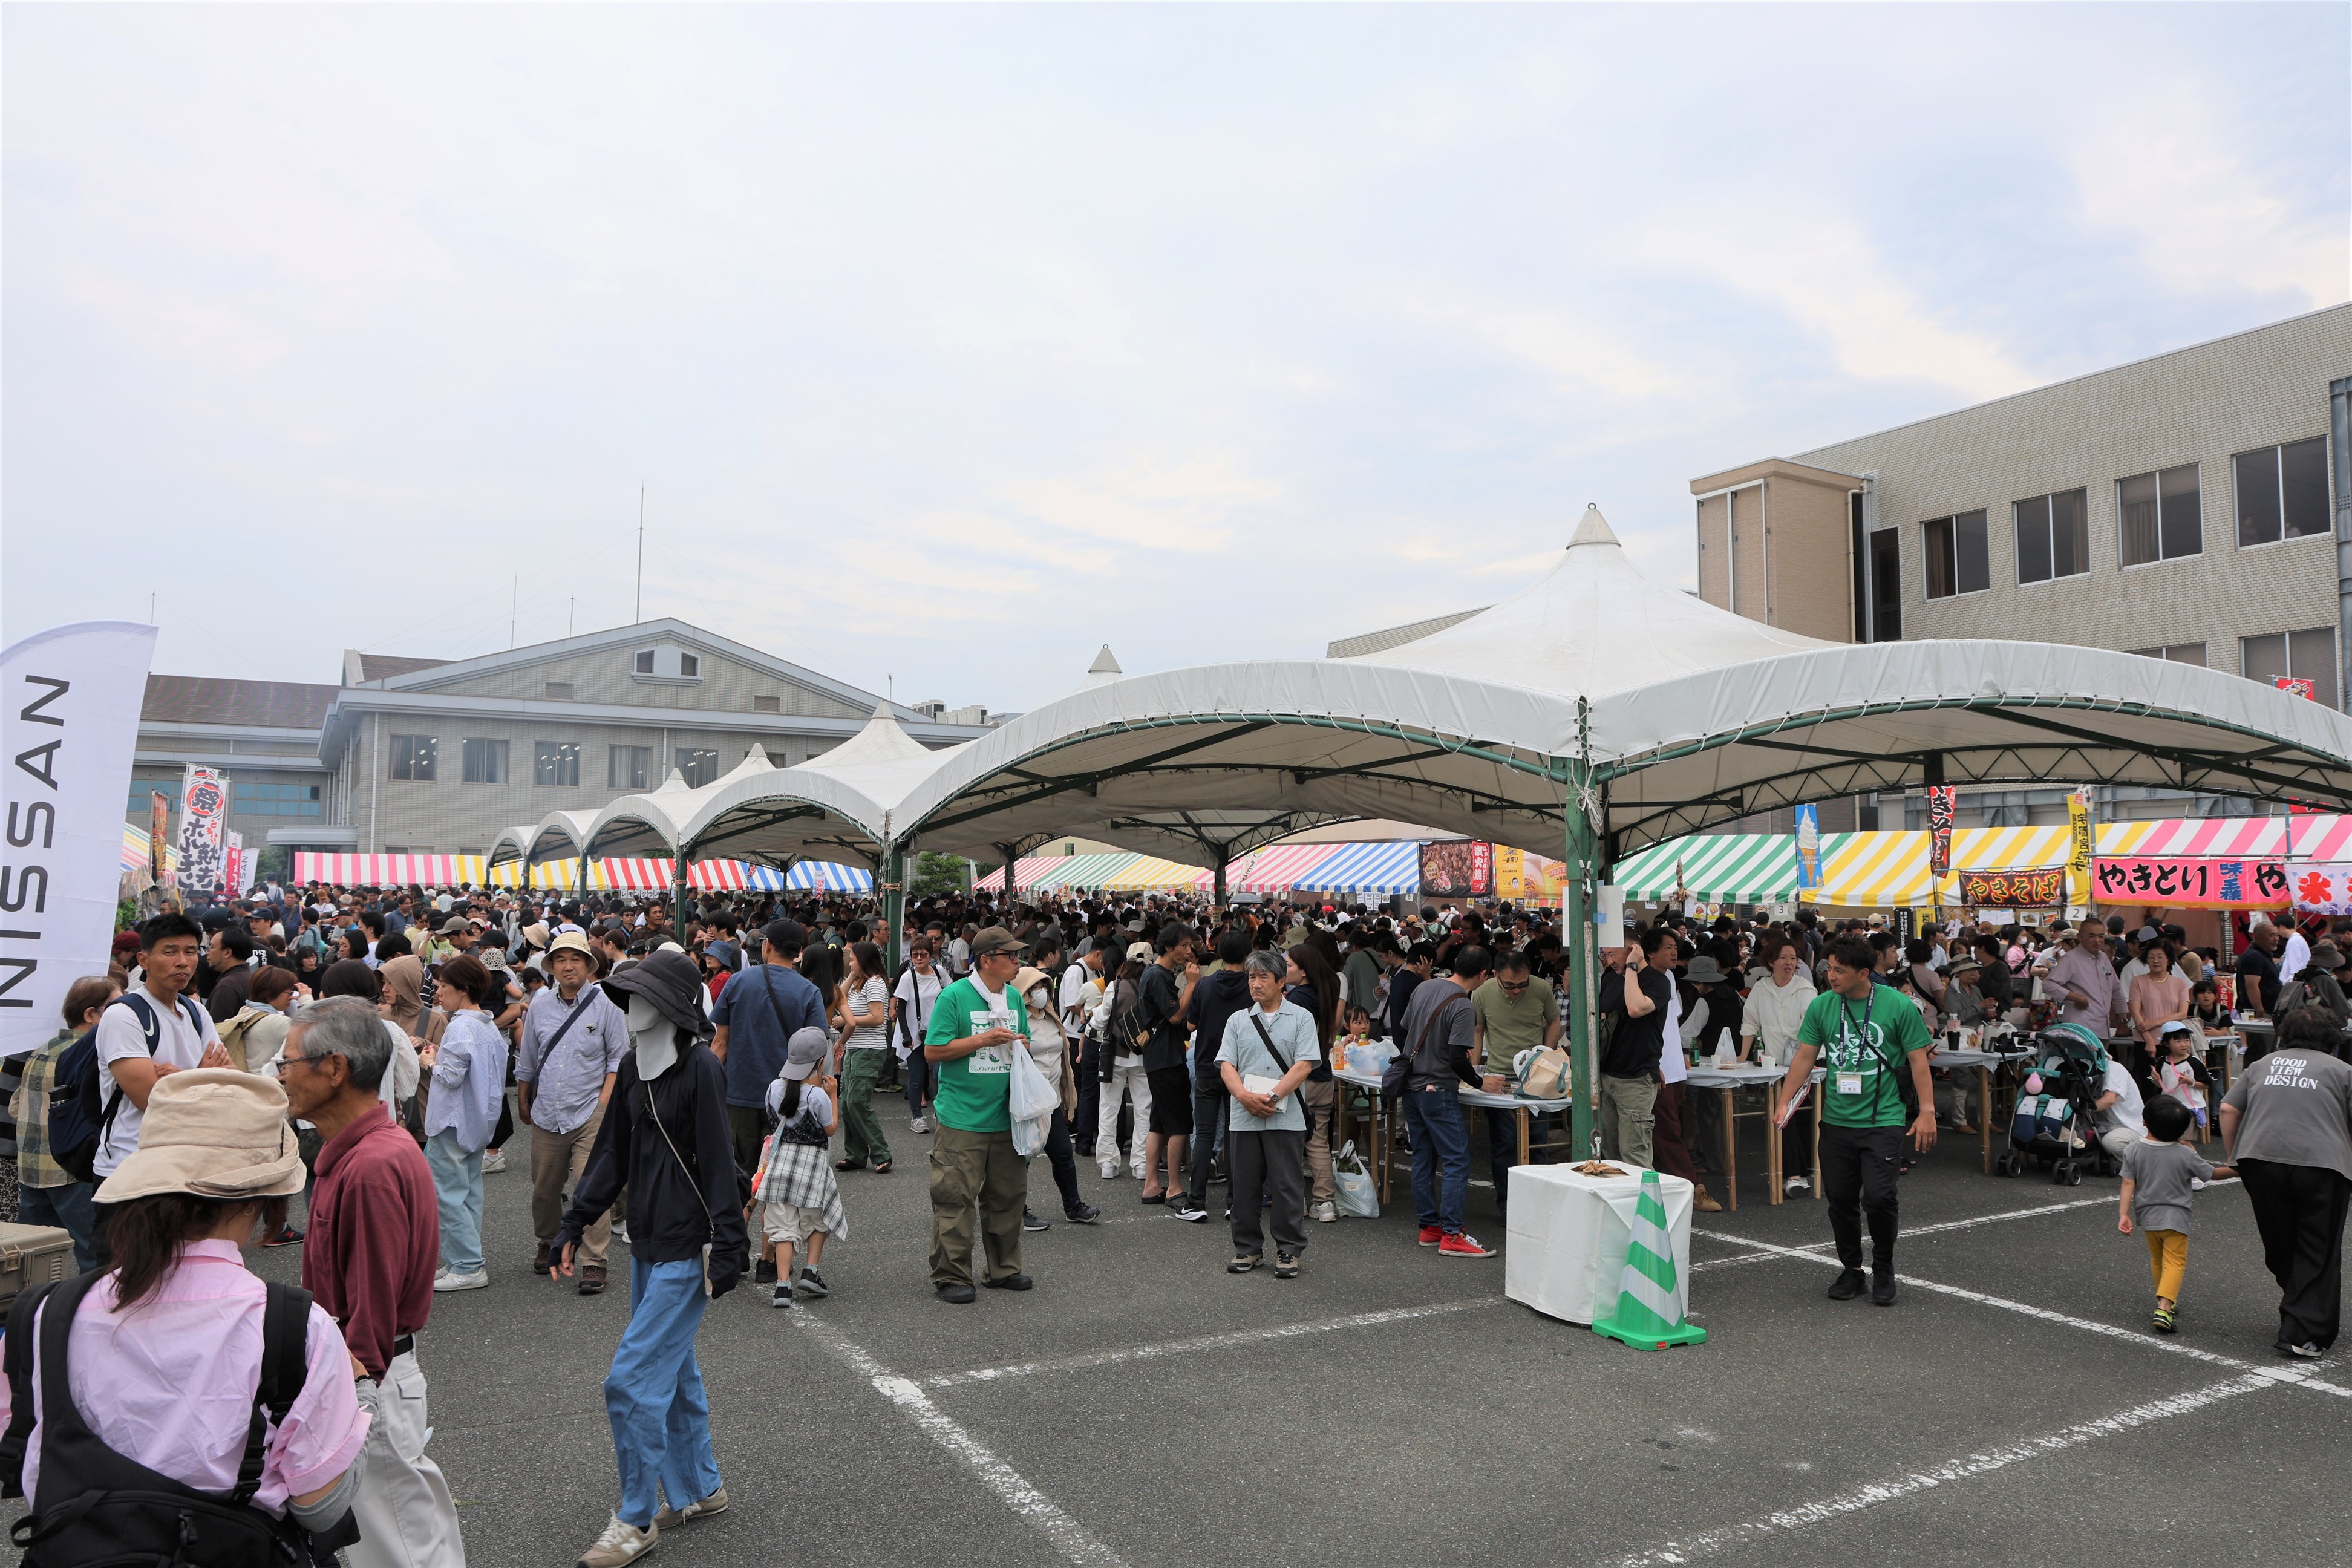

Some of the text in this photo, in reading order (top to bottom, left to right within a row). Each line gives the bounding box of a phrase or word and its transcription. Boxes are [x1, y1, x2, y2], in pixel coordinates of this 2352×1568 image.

[0, 674, 70, 1008] NISSAN
[239, 856, 248, 895] ISSAN
[1967, 873, 2059, 903] やきそば
[2098, 862, 2208, 897] やきとり
[2219, 863, 2243, 901] 味の王様
[2255, 863, 2290, 898] や
[2298, 871, 2333, 904] 氷
[1779, 905, 1783, 914] 3
[2072, 908, 2079, 918] 2
[2270, 1065, 2304, 1076] VIEW
[2272, 1057, 2307, 1068] GOOD
[2264, 1074, 2319, 1090] DESIGN
